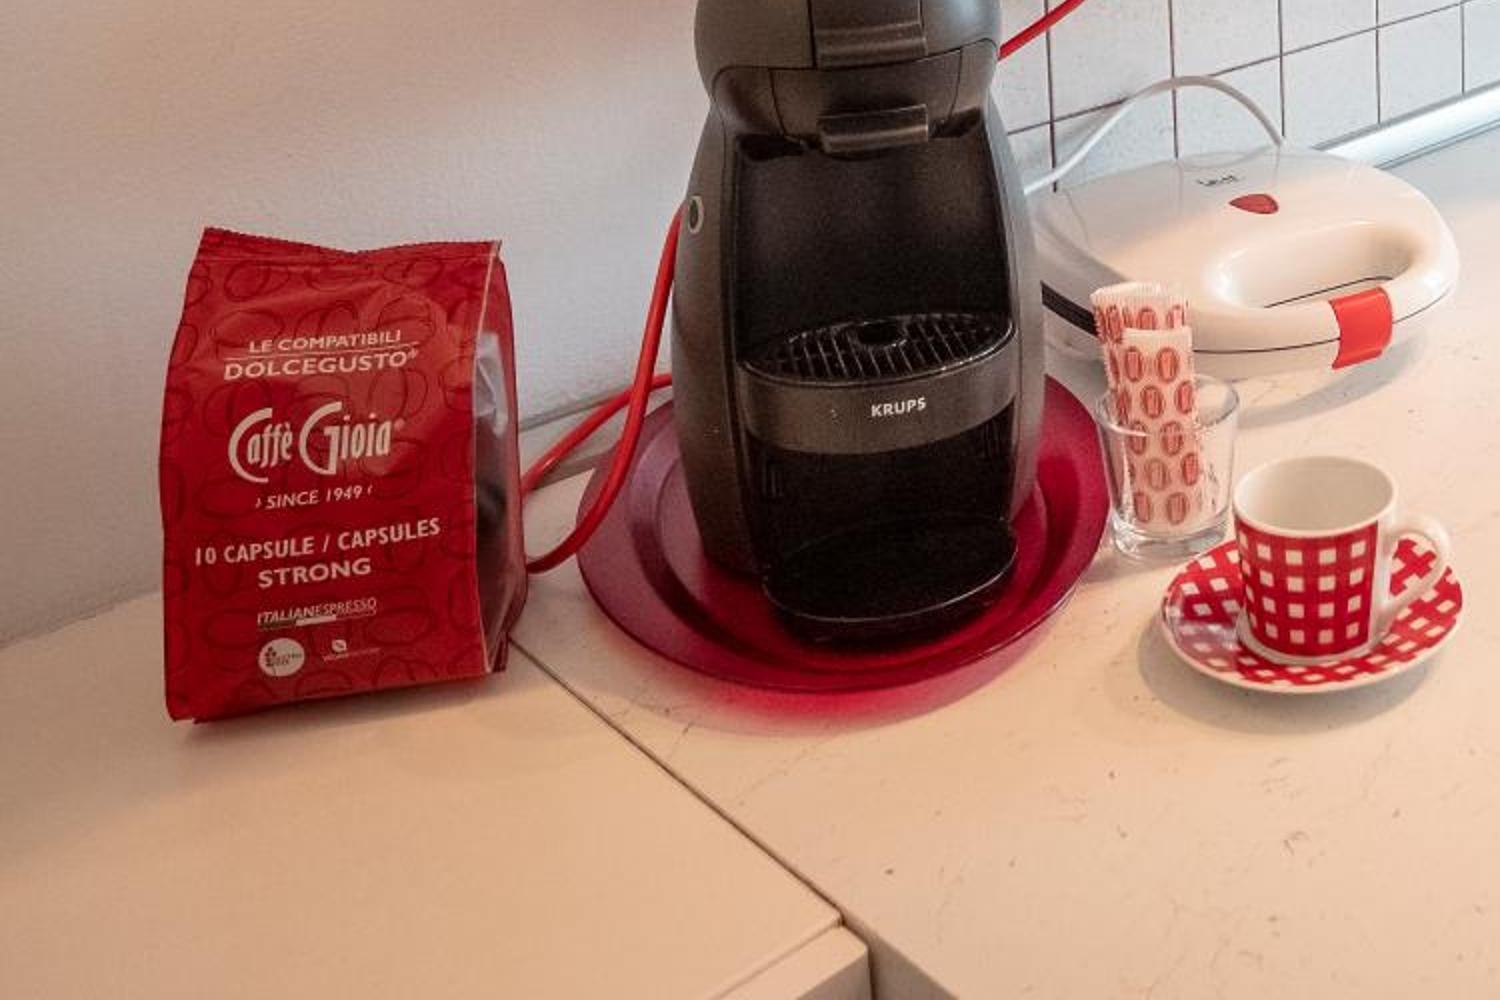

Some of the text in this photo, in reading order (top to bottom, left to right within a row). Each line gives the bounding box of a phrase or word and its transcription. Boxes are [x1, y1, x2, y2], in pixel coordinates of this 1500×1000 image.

[249, 329, 401, 354] LE COMPATIBILI
[871, 397, 926, 417] KRUPS
[228, 401, 393, 483] Caffè Gioia
[265, 484, 362, 510] SINCE 1949
[195, 546, 217, 566] 10
[223, 536, 315, 564] CAPSULE
[338, 517, 441, 551] CAPSULES
[258, 557, 372, 588] STRONG
